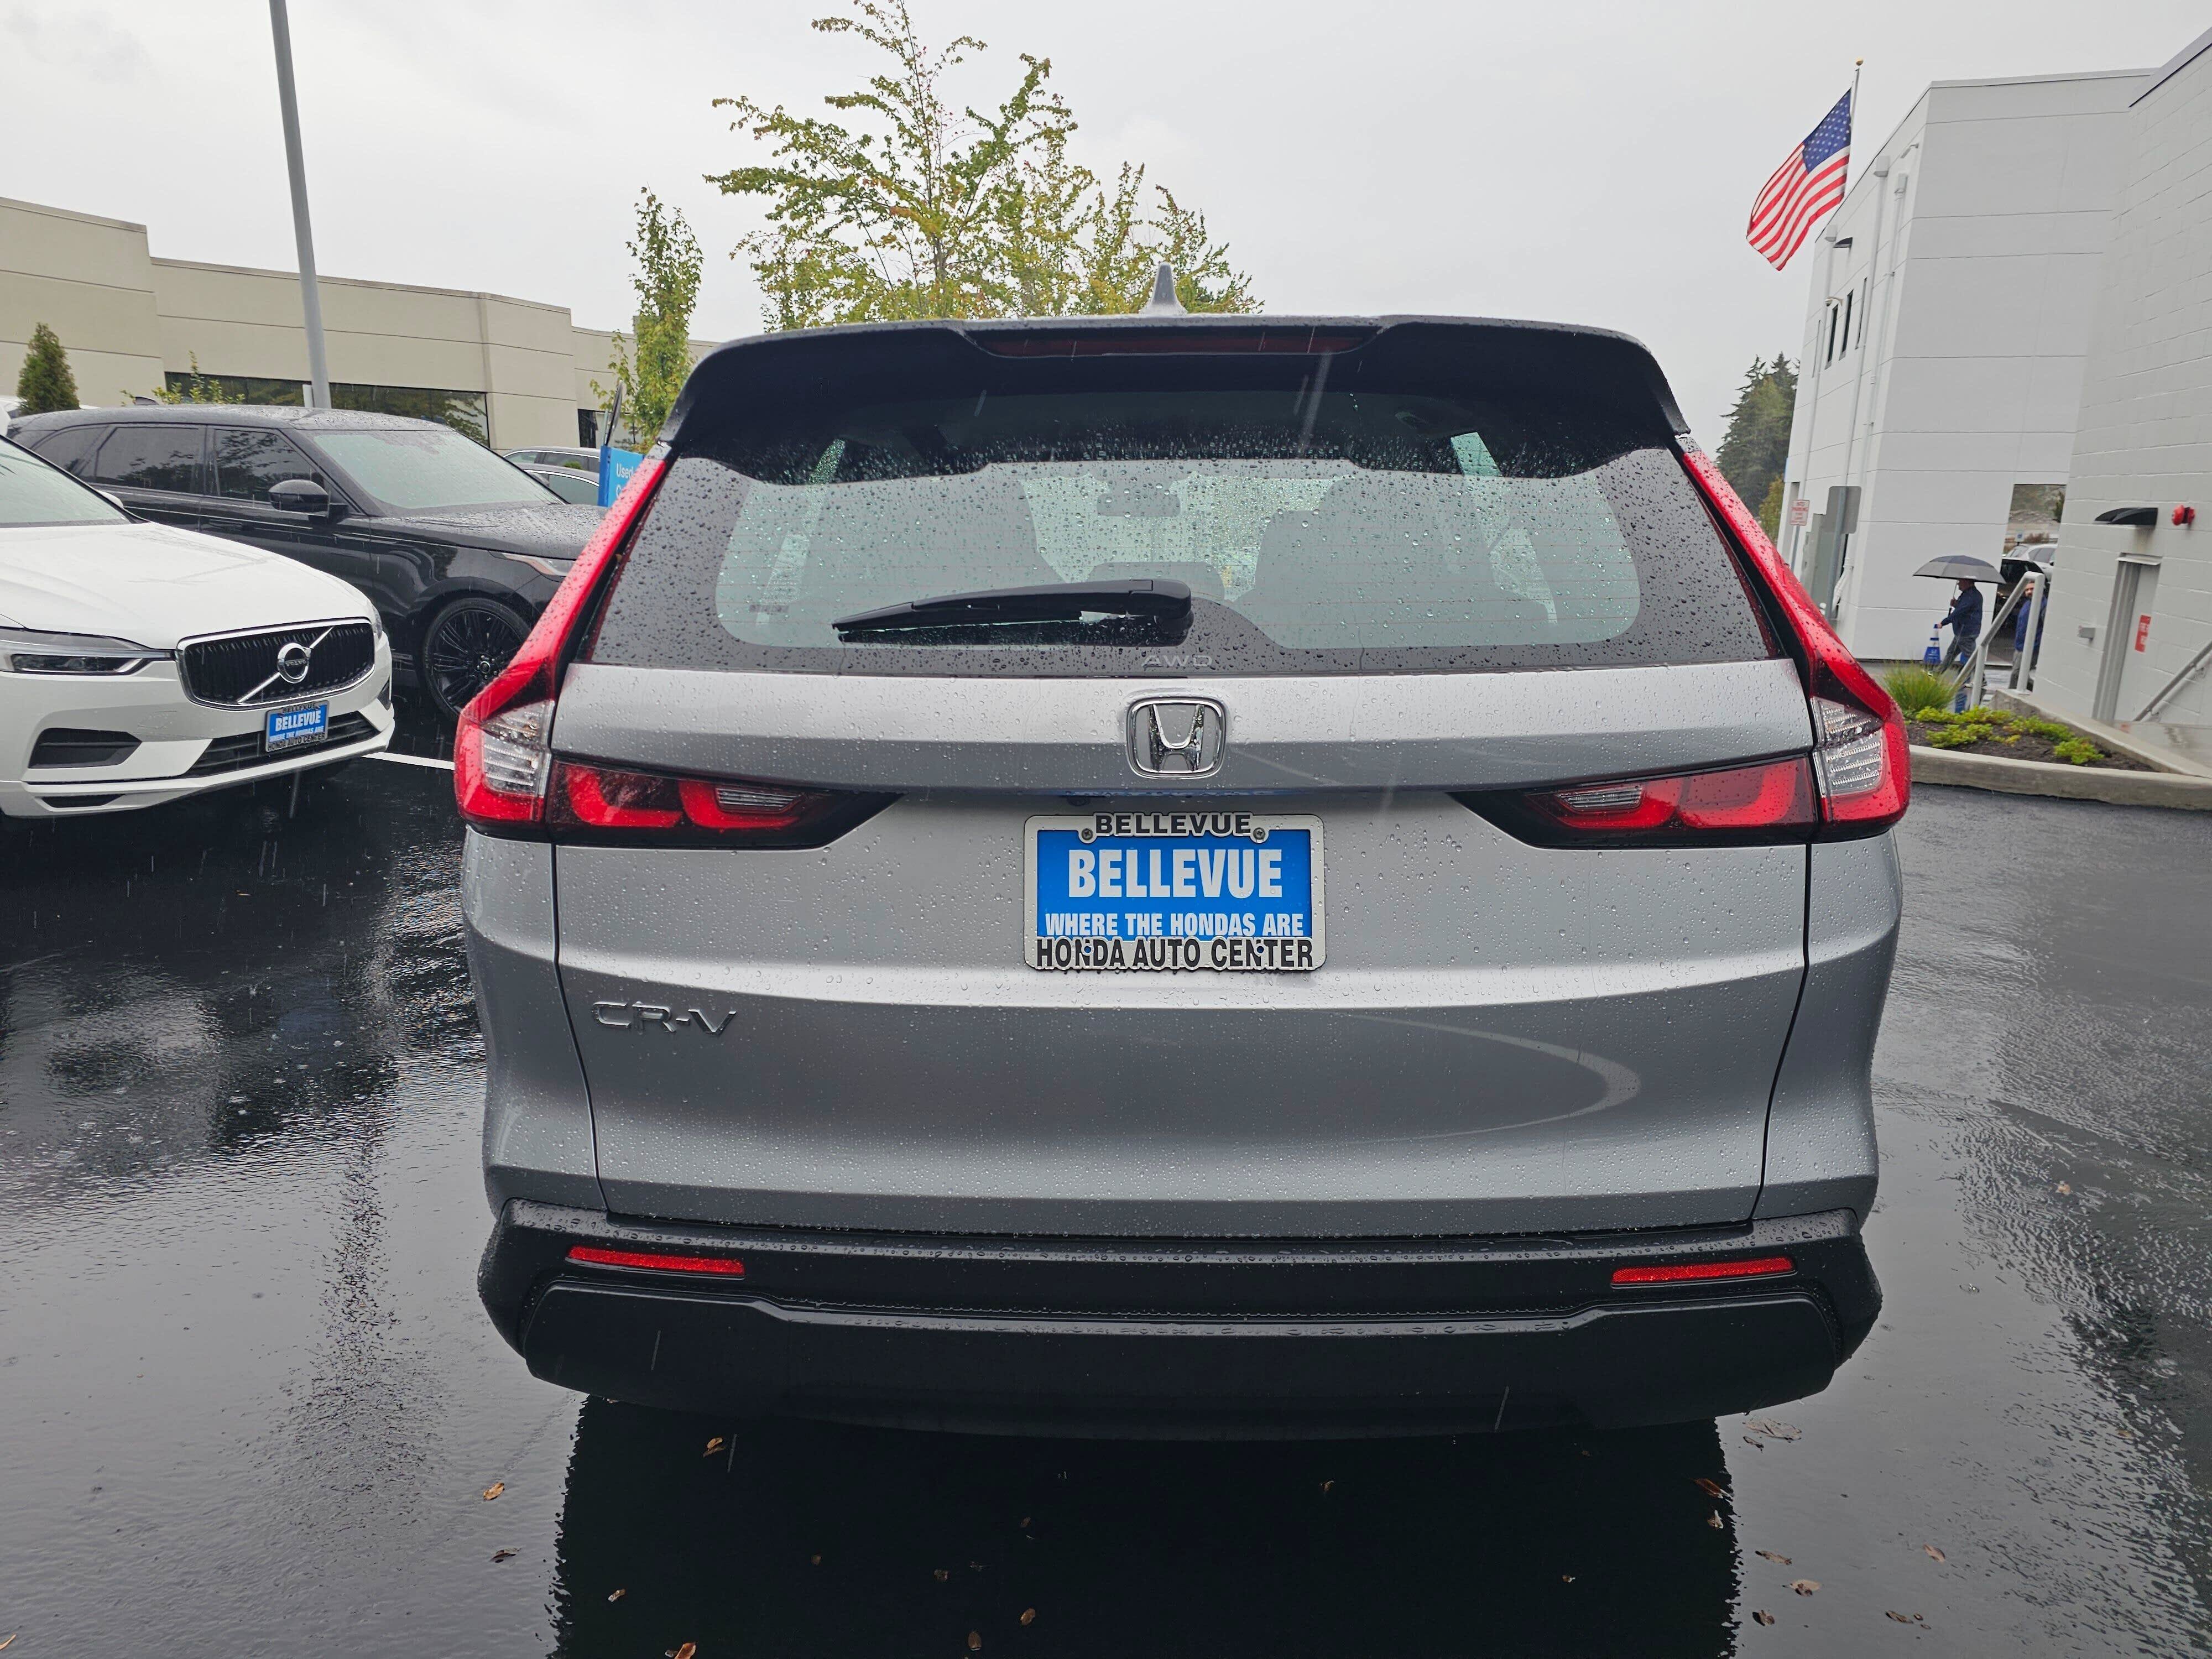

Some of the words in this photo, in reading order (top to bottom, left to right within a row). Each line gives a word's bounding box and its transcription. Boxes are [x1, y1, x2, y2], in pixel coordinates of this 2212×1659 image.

[1141, 655, 1213, 667] AWD
[275, 710, 321, 732] BELLEVUE
[1095, 815, 1251, 834] BELLEVUE
[1068, 849, 1282, 898] BELLEVUE
[1045, 913, 1118, 936] WHERE
[1125, 914, 1162, 936] THE
[1171, 914, 1255, 936] HONDAS
[1263, 914, 1303, 936] ARE
[1037, 939, 1125, 967] HONDA
[1133, 939, 1200, 967] AUTO
[1211, 939, 1312, 967] CENTER
[592, 1001, 737, 1035] CR-V
